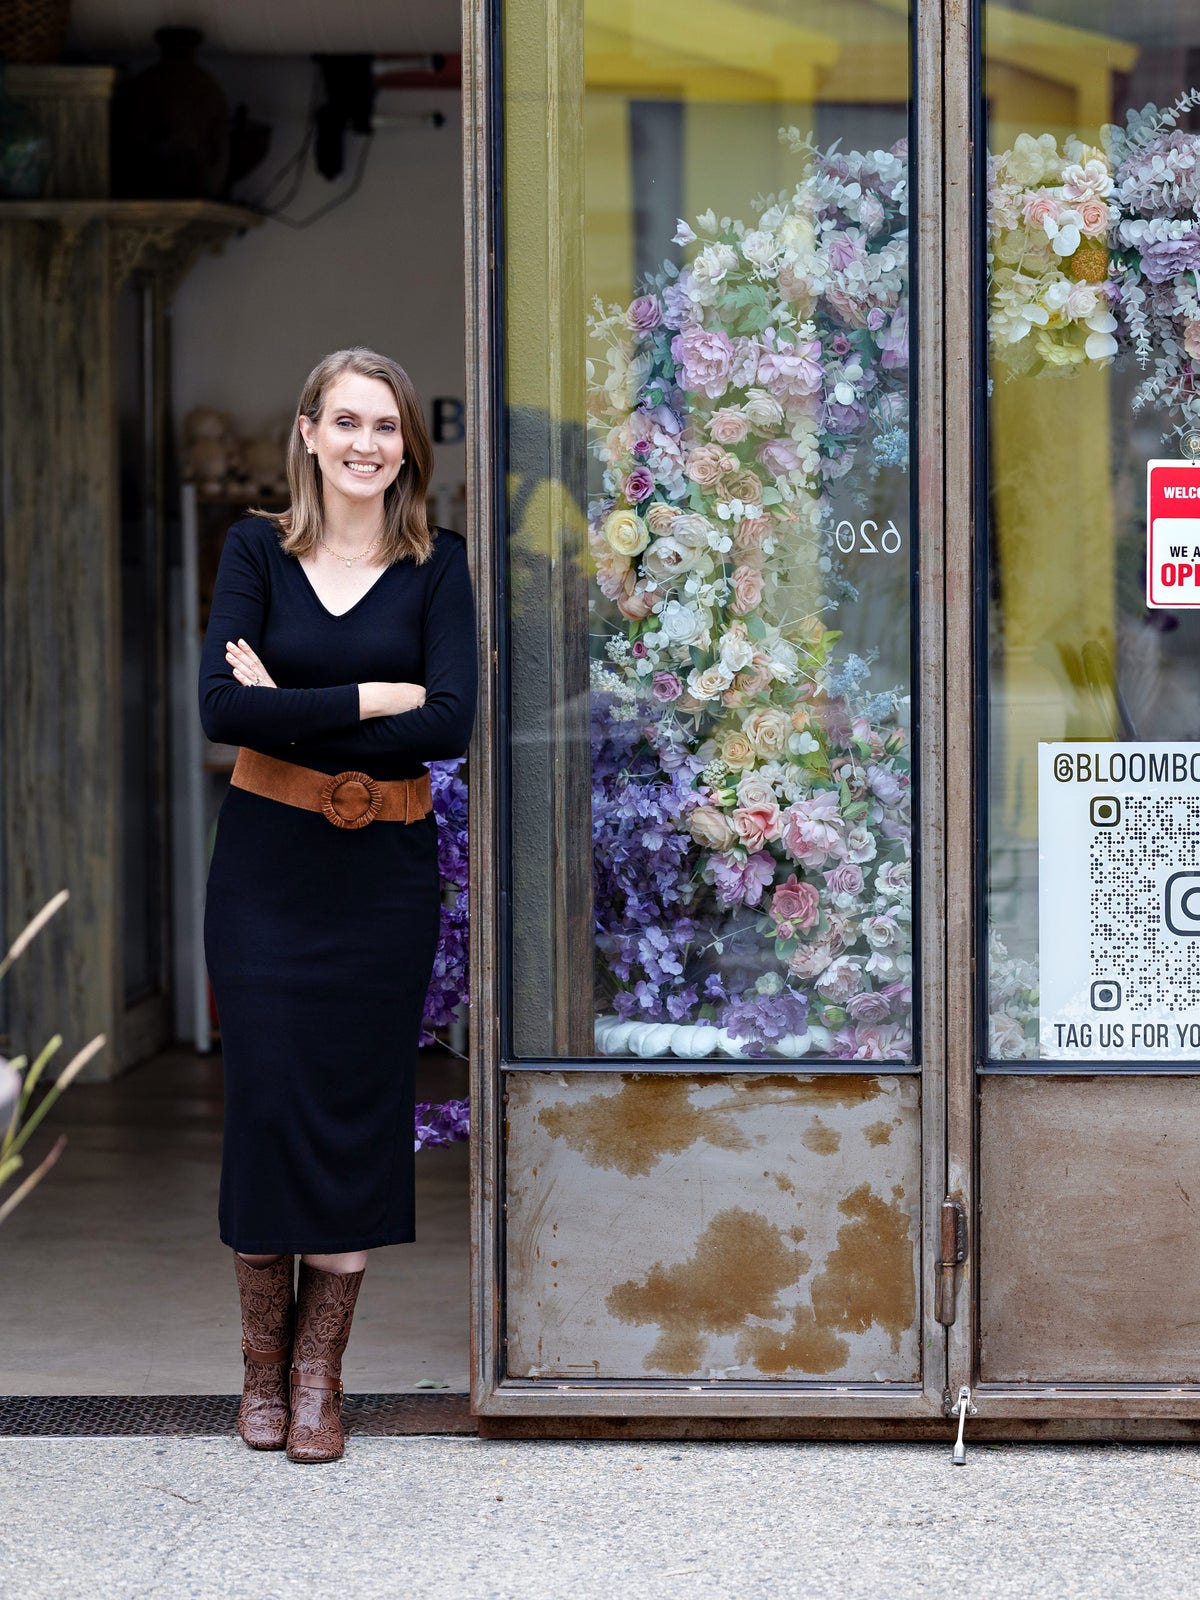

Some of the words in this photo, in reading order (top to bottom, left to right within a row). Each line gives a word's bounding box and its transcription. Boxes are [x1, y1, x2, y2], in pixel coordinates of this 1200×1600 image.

[1170, 546, 1188, 558] WE
[1054, 1023, 1092, 1048] TAG
[1099, 1023, 1124, 1048] US
[1131, 1023, 1169, 1048] FOR
